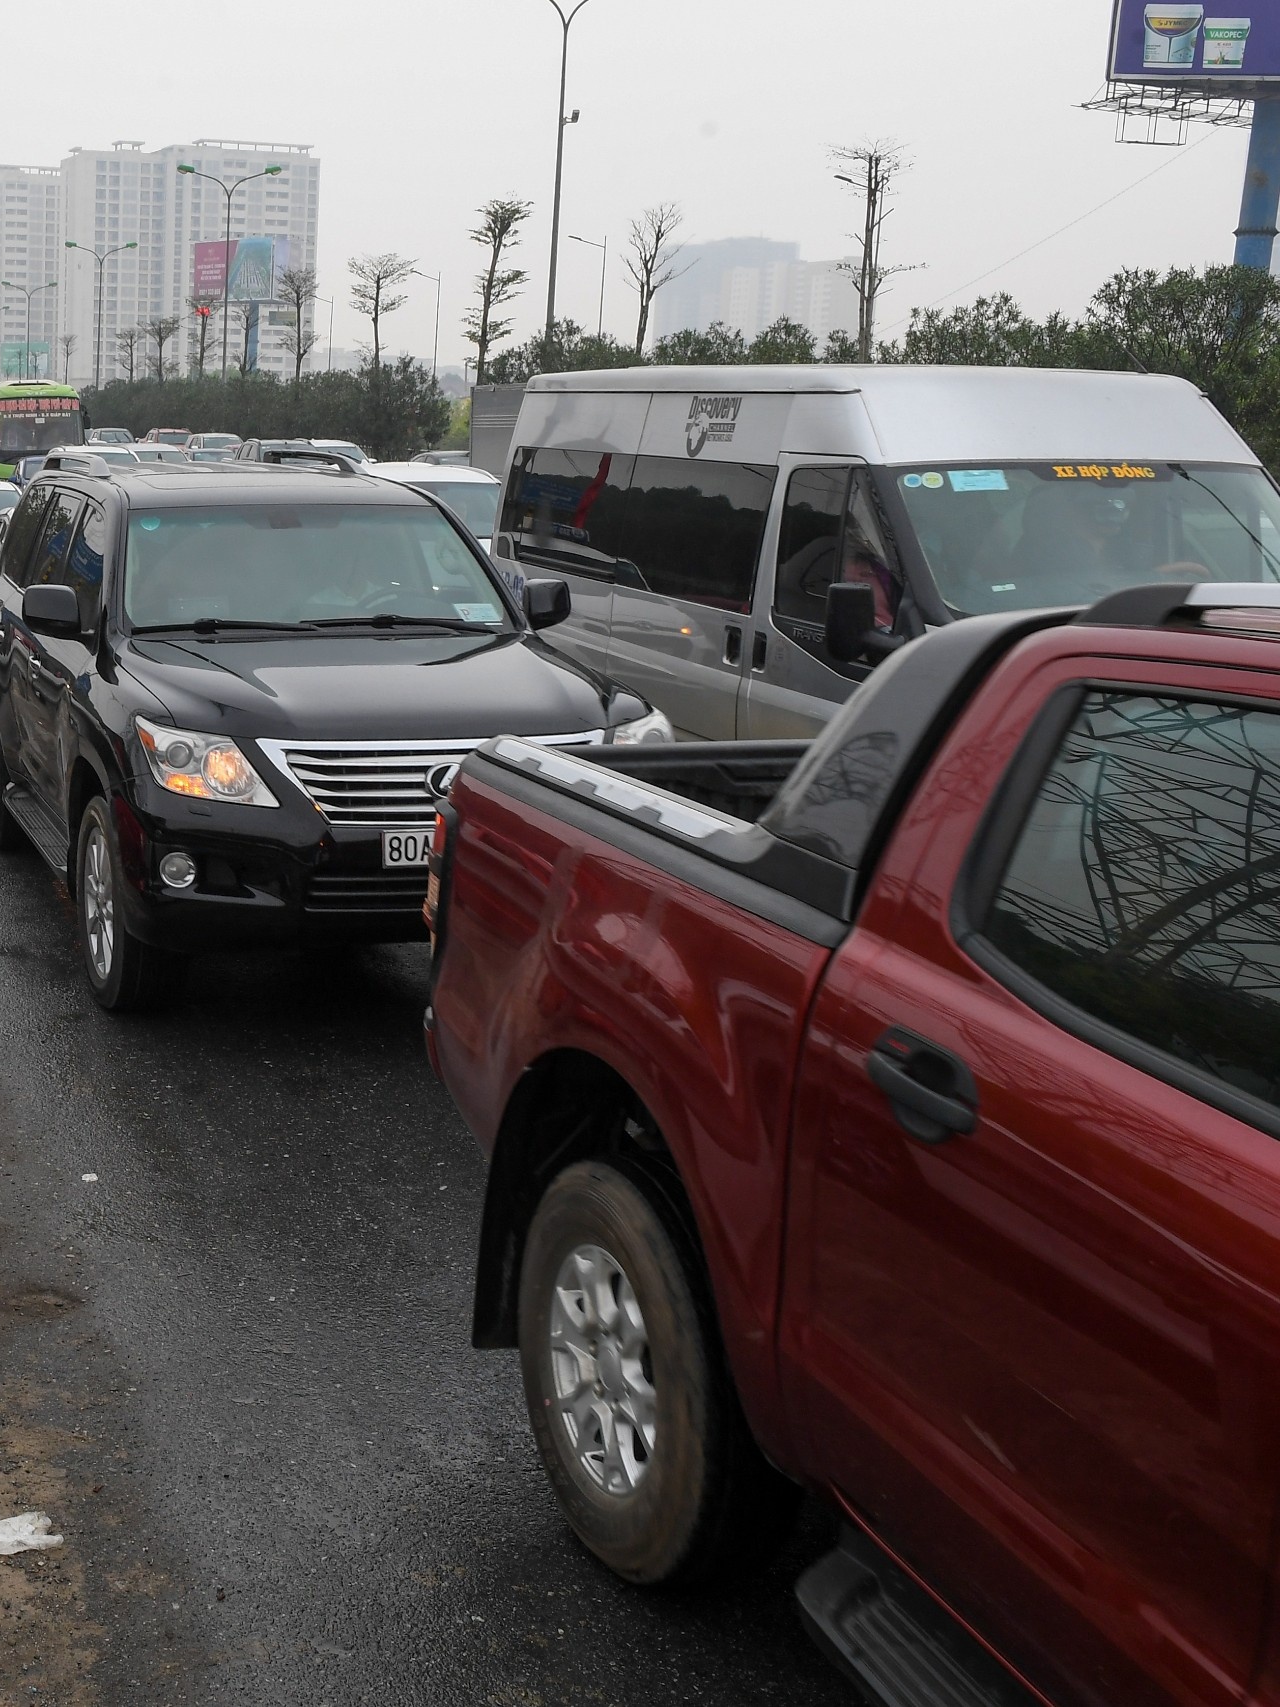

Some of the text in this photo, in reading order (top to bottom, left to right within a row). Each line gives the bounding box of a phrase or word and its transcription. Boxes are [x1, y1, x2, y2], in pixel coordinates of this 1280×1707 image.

[1210, 31, 1243, 39] VAKOPEC
[1052, 462, 1155, 480] XE HỢP ĐỒNG
